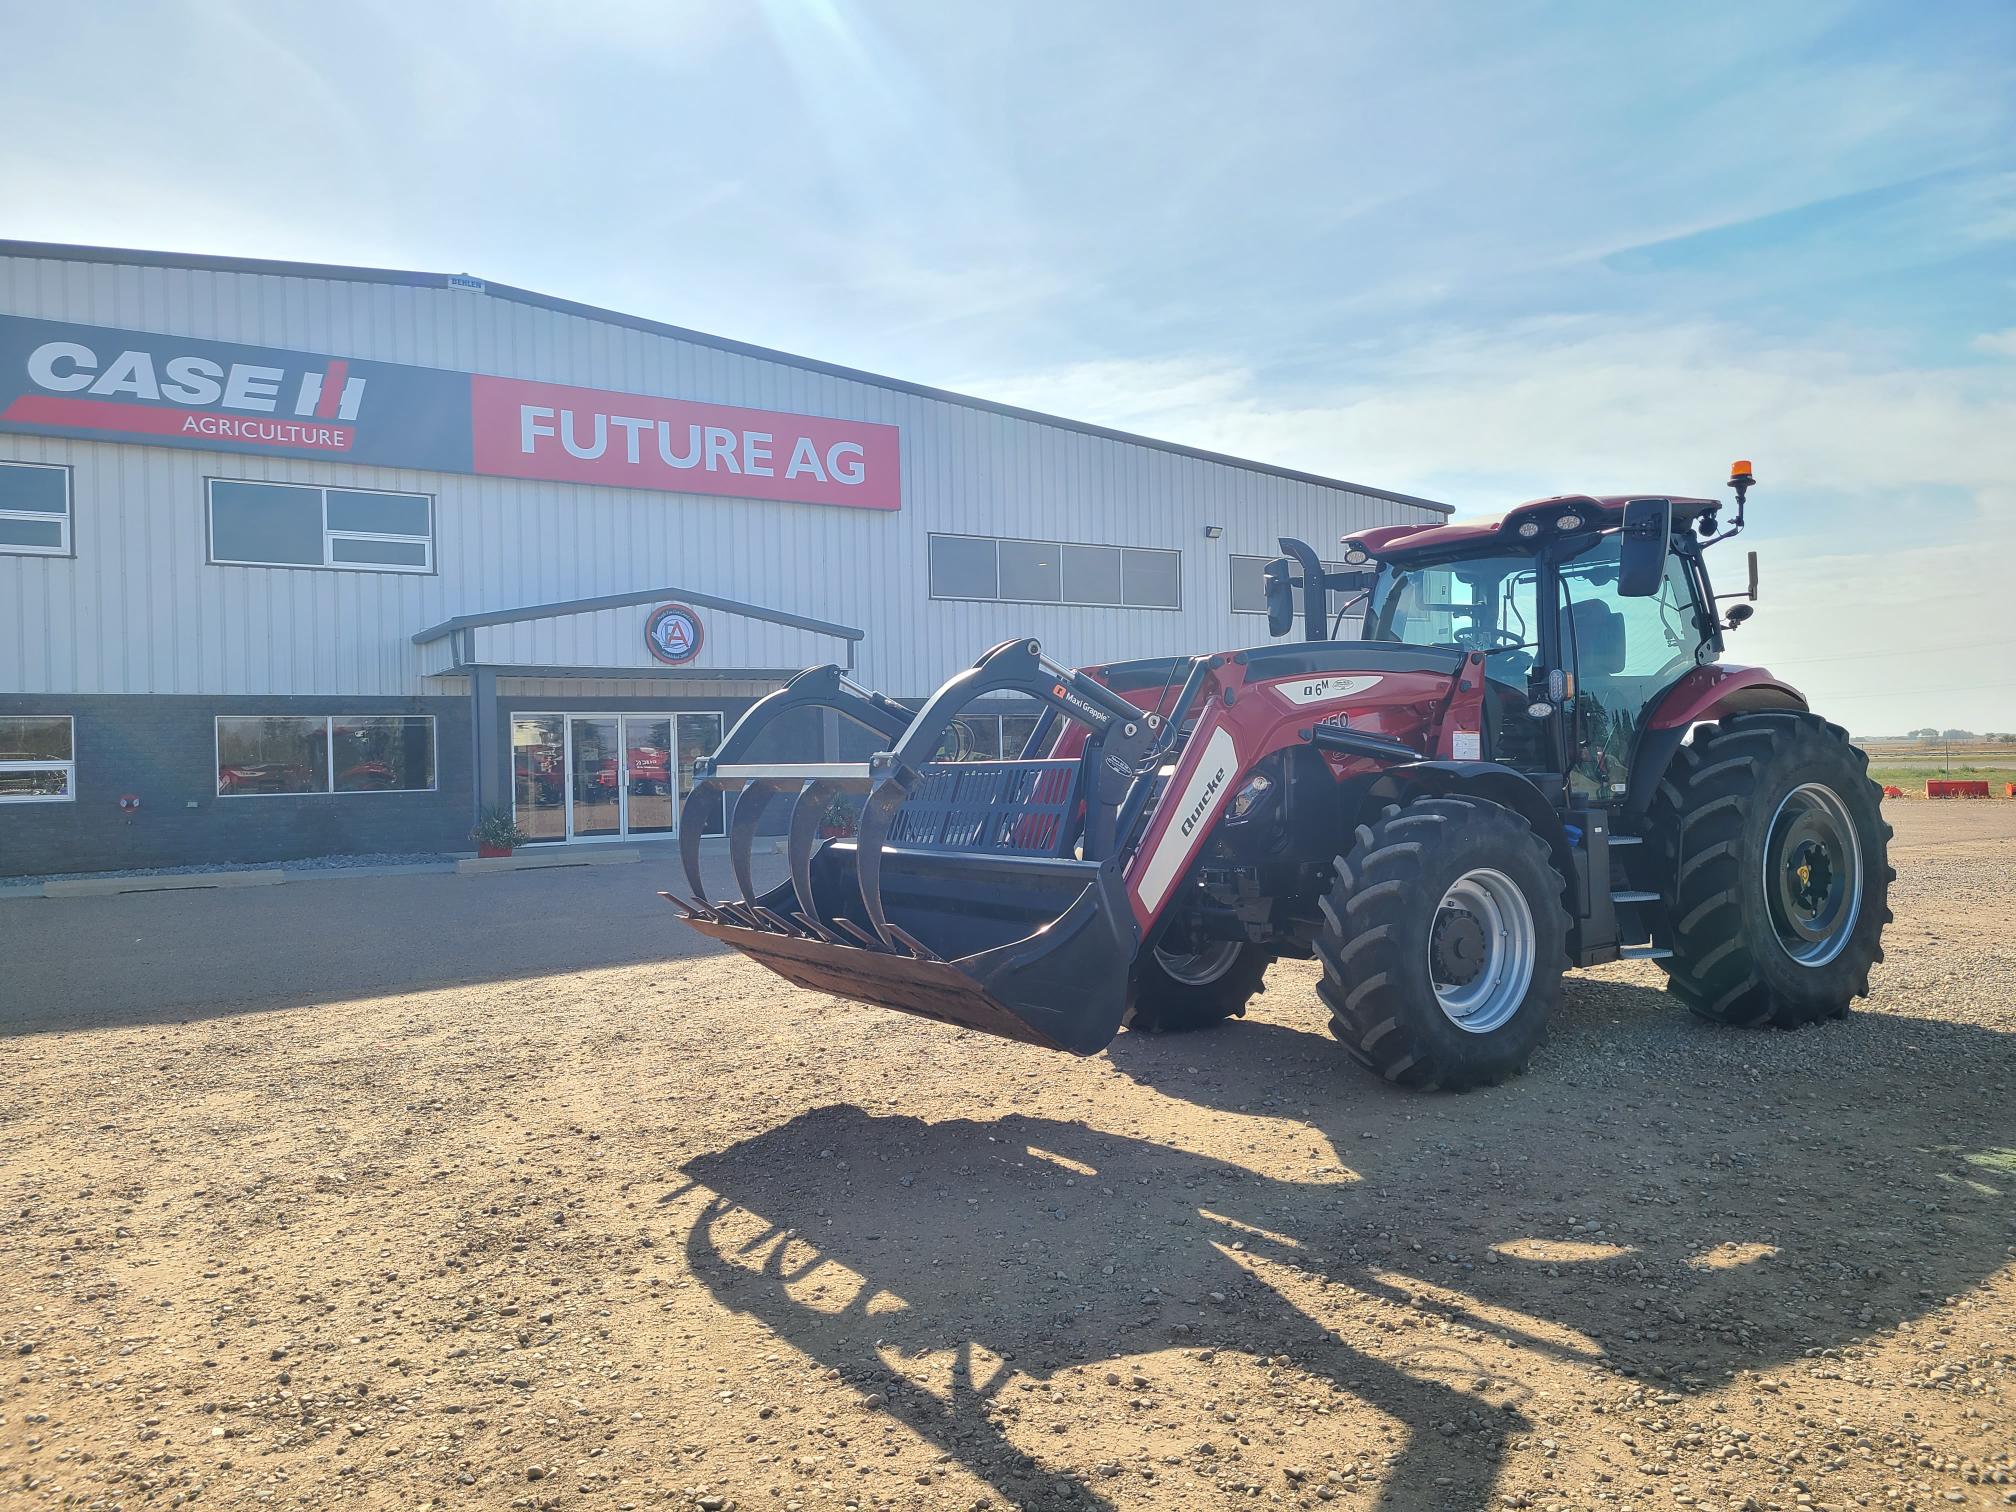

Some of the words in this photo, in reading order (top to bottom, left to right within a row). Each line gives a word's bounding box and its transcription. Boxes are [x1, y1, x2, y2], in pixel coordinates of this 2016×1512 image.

[27, 342, 284, 412] CASE
[182, 415, 345, 447] AGRICULTURE
[520, 404, 774, 477] FUTURE
[785, 437, 865, 485] AG
[1065, 692, 1083, 708] Maxi
[1181, 767, 1225, 837] Quicke
